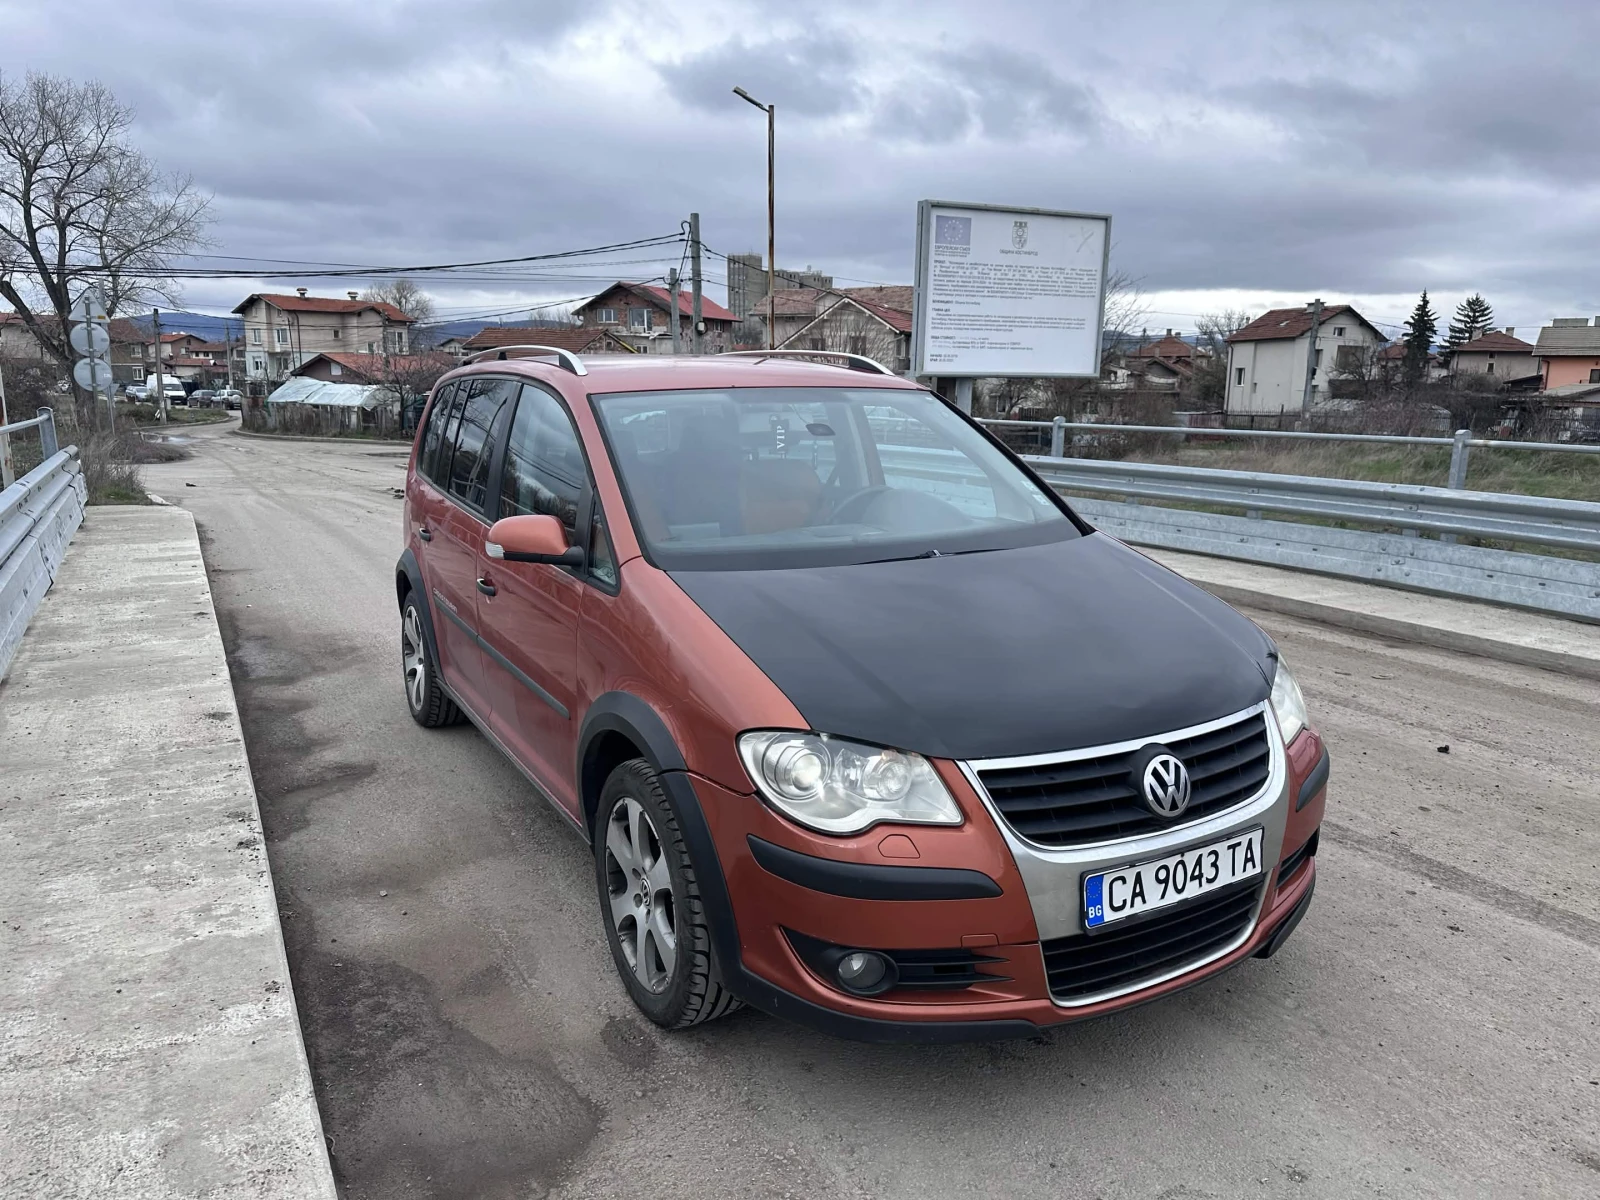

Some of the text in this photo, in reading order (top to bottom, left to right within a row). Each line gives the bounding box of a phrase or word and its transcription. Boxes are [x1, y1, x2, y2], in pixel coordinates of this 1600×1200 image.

[776, 425, 785, 449] VIP
[1108, 837, 1257, 912] CA 9043 TA
[1088, 904, 1102, 919] BG
